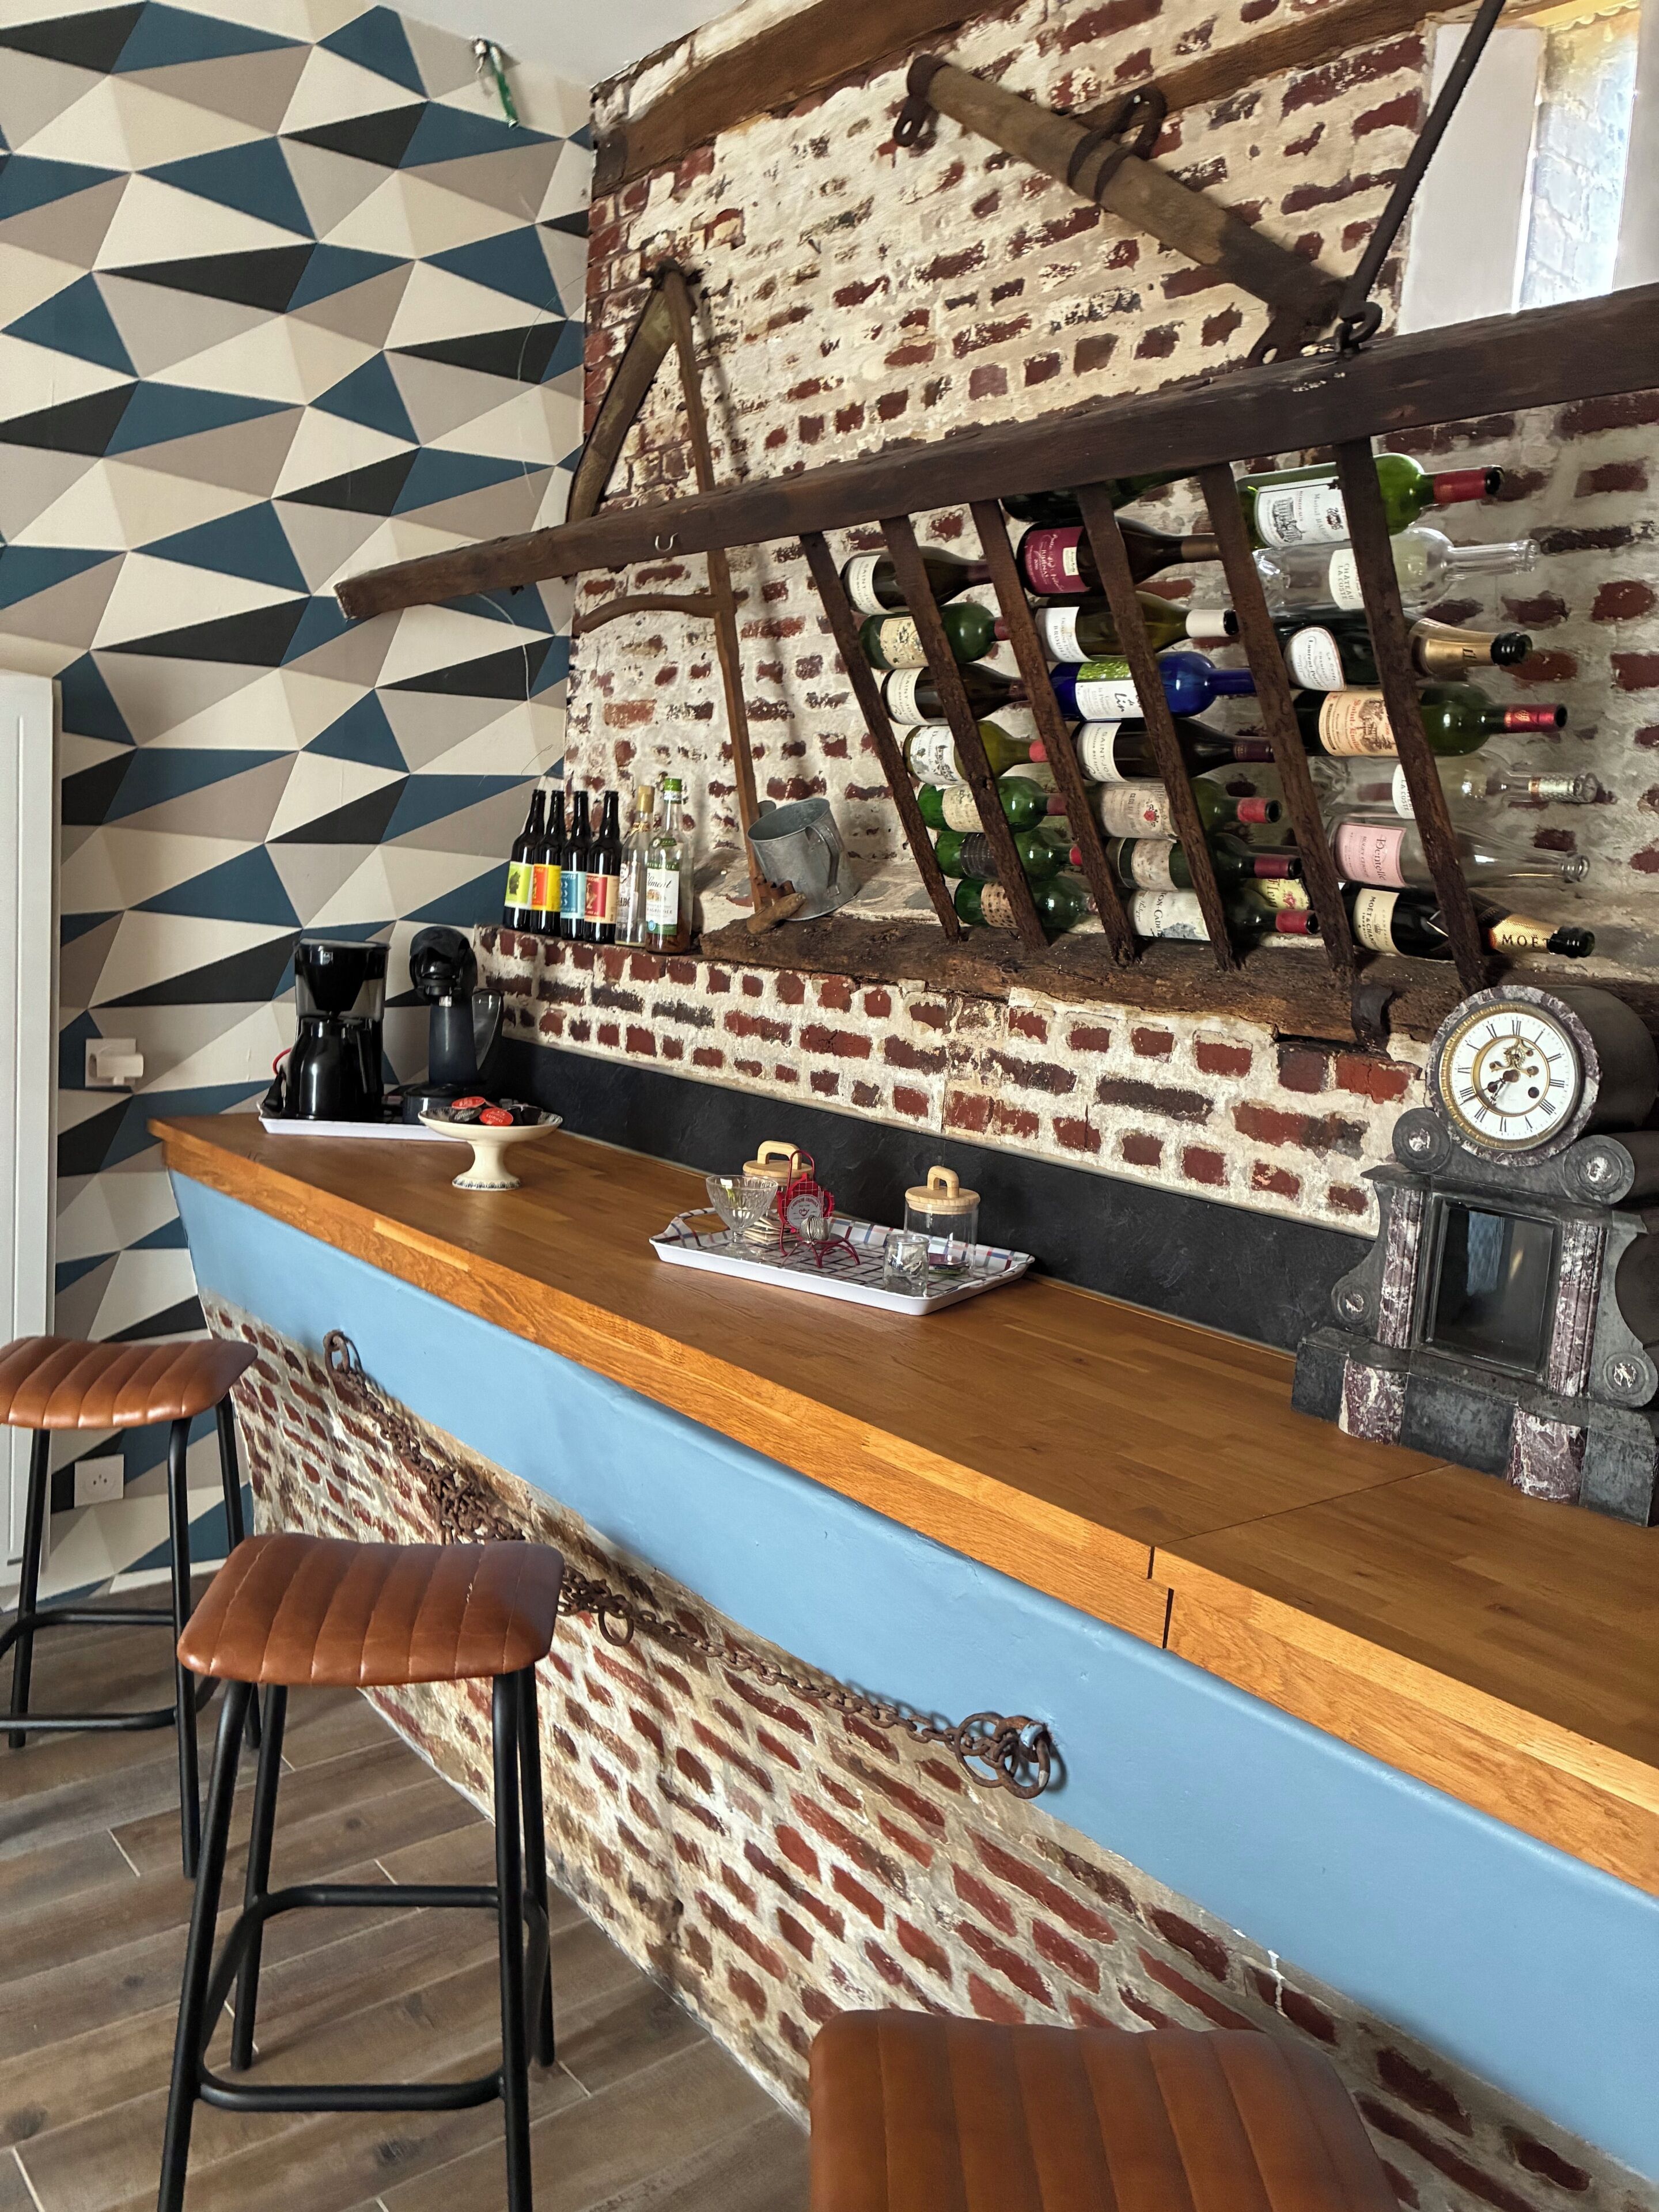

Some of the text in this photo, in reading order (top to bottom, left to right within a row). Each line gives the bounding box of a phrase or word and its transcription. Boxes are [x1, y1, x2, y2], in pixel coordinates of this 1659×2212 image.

[1338, 565, 1347, 600] LA COSTE
[1114, 694, 1127, 712] Lin
[1401, 779, 1406, 789] LA
[1374, 839, 1387, 881] Dentelle
[1366, 896, 1376, 917] MOËT
[1502, 934, 1550, 948] MOËT
[1550, 1079, 1565, 1088] III
